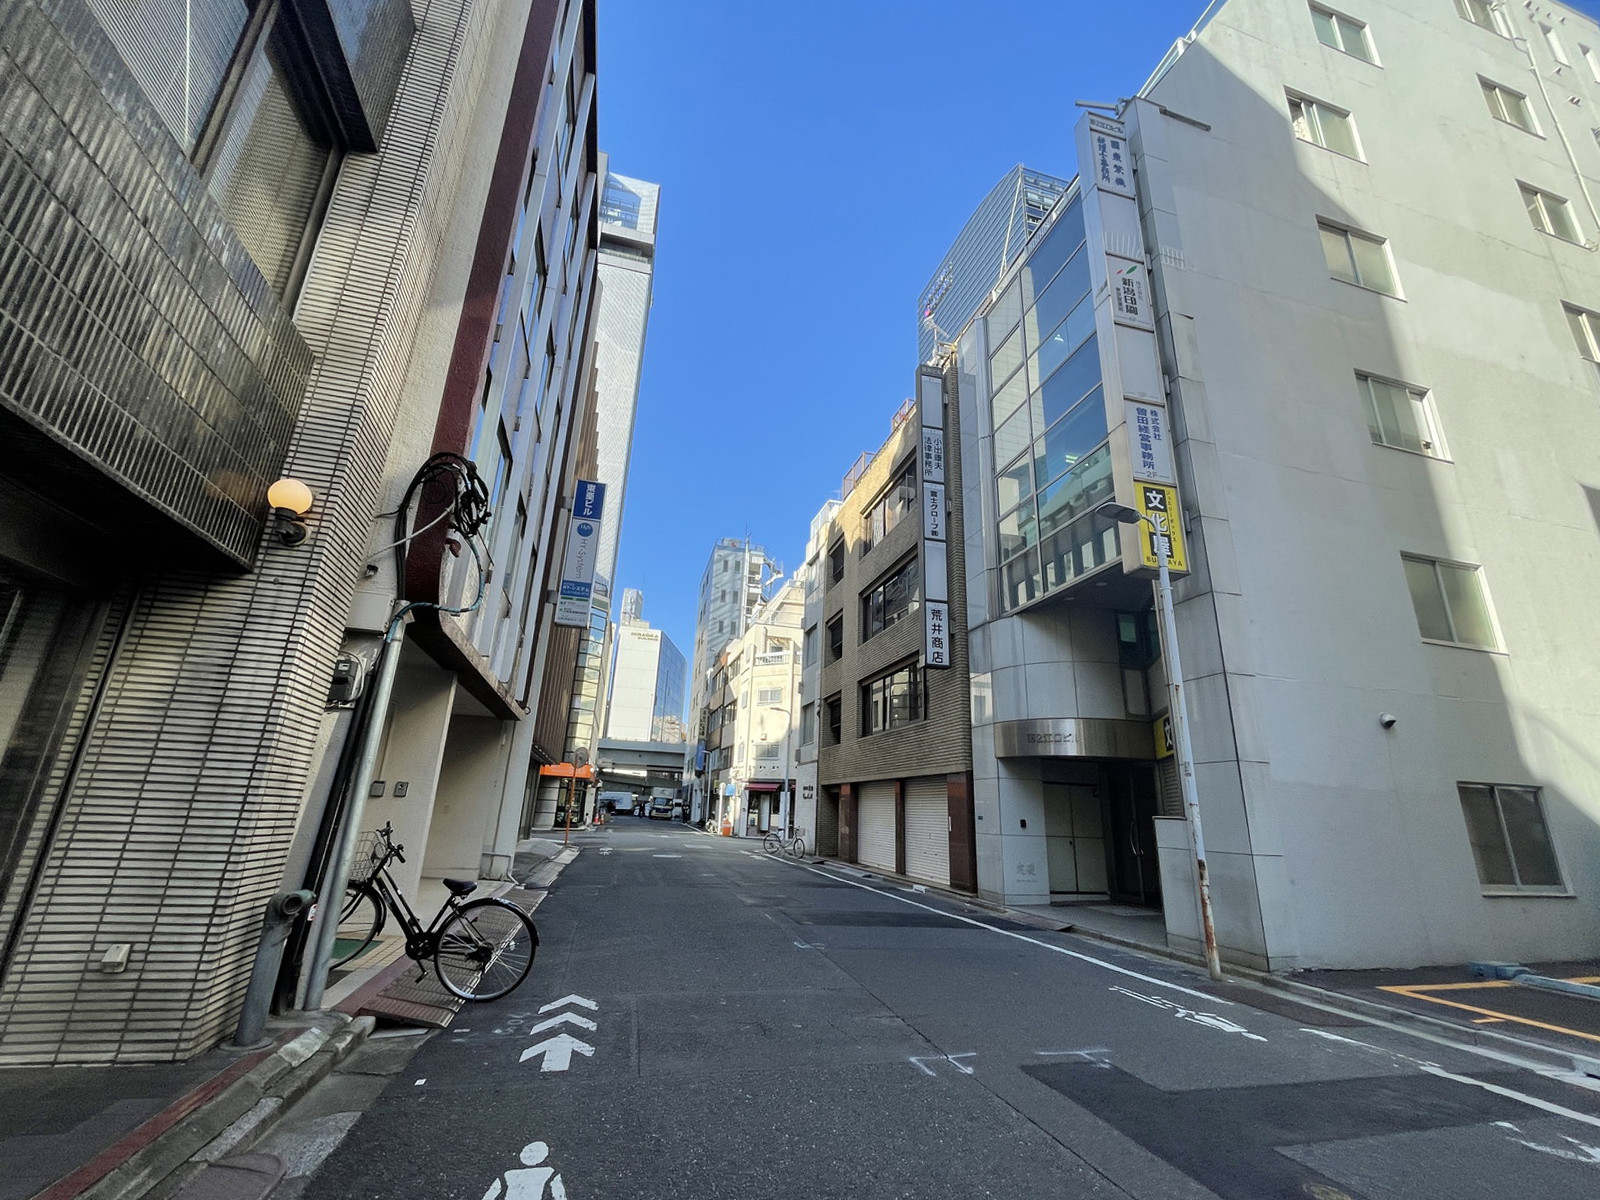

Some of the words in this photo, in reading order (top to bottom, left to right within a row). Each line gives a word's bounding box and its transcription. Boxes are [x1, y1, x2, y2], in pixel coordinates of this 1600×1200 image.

[1150, 409, 1162, 441] 株式会社
[924, 436, 933, 477] 法律事務所
[933, 438, 942, 471] 小出康夫
[1146, 490, 1171, 556] 文化屋
[1146, 556, 1183, 567] BUAYA
[930, 609, 943, 664] 荒井商店
